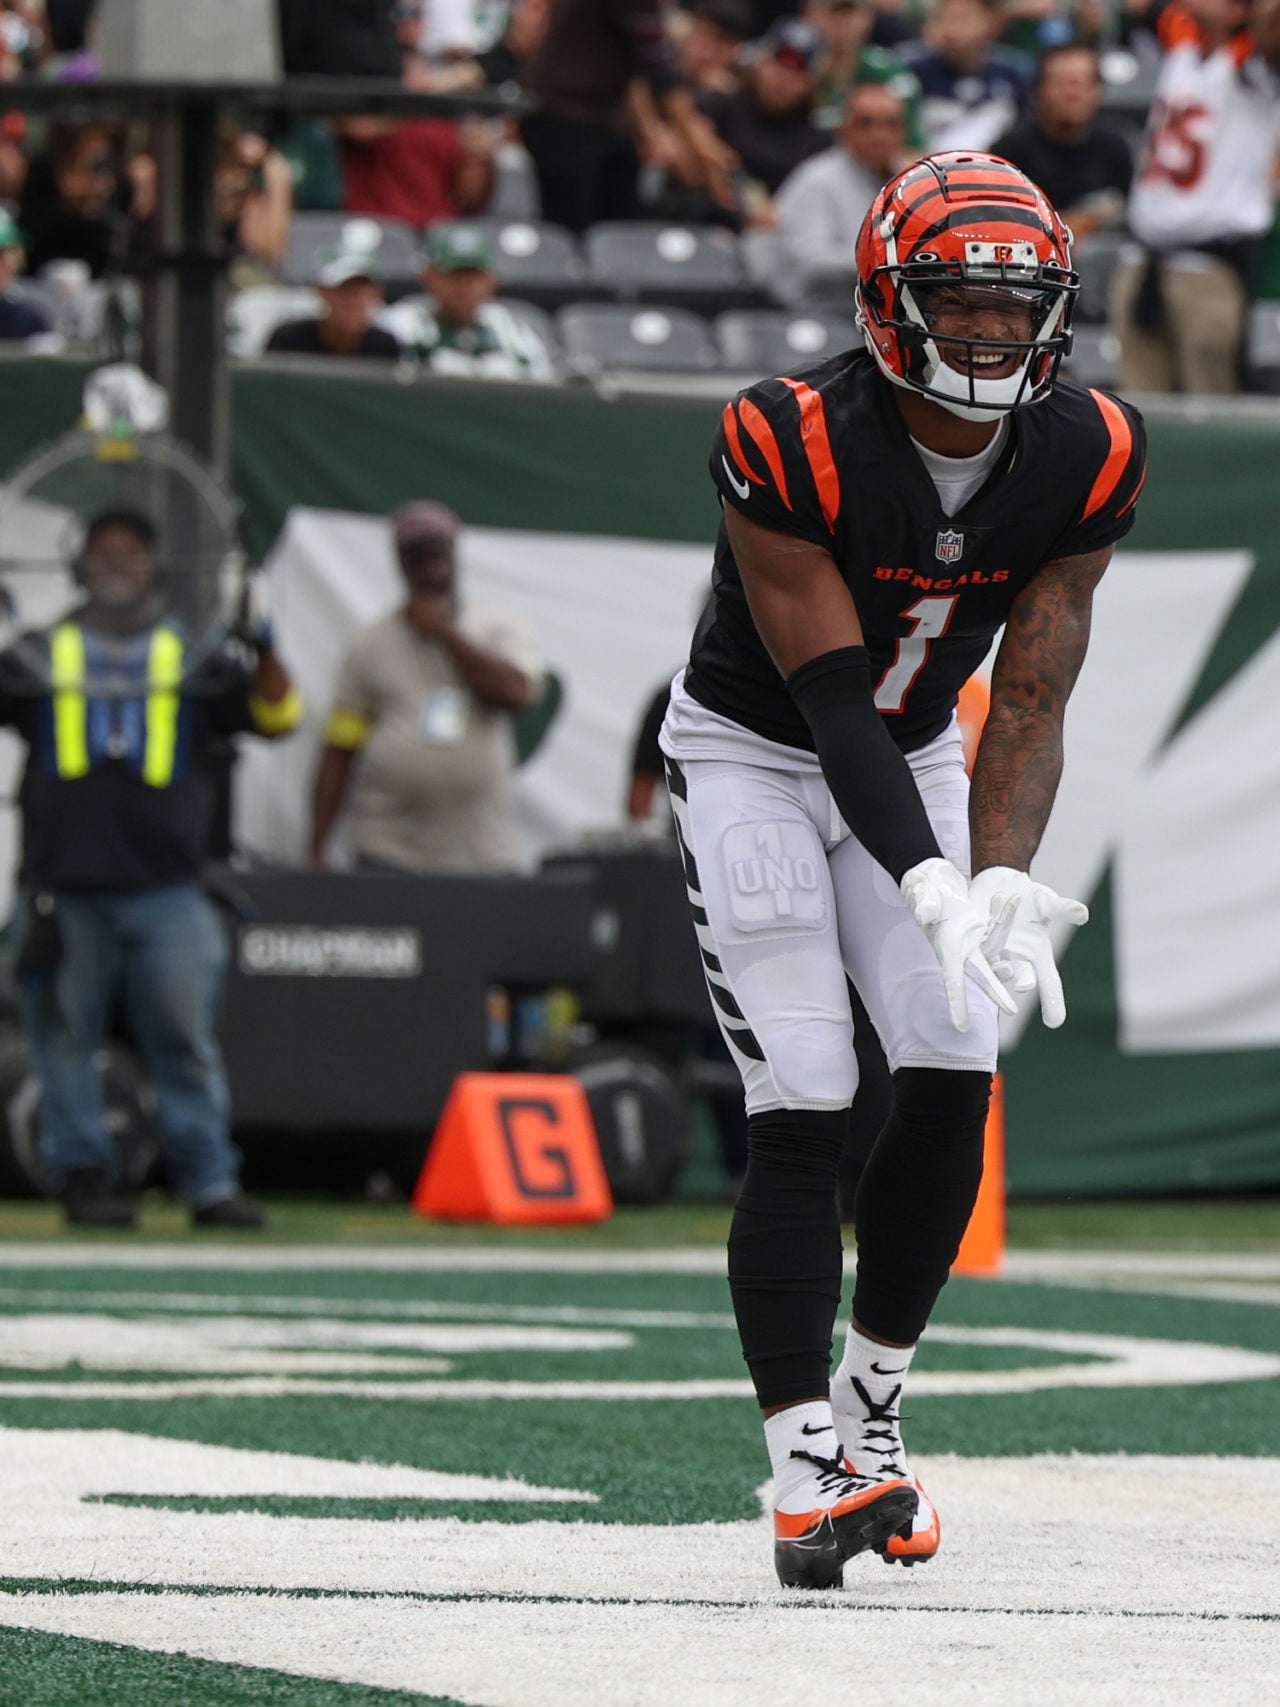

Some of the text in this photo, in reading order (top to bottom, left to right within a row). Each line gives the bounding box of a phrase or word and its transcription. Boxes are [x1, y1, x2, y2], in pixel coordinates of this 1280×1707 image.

[872, 567, 1010, 591] BENGALS
[872, 594, 960, 714] 1
[734, 857, 819, 894] UNO
[497, 1097, 577, 1198] G
